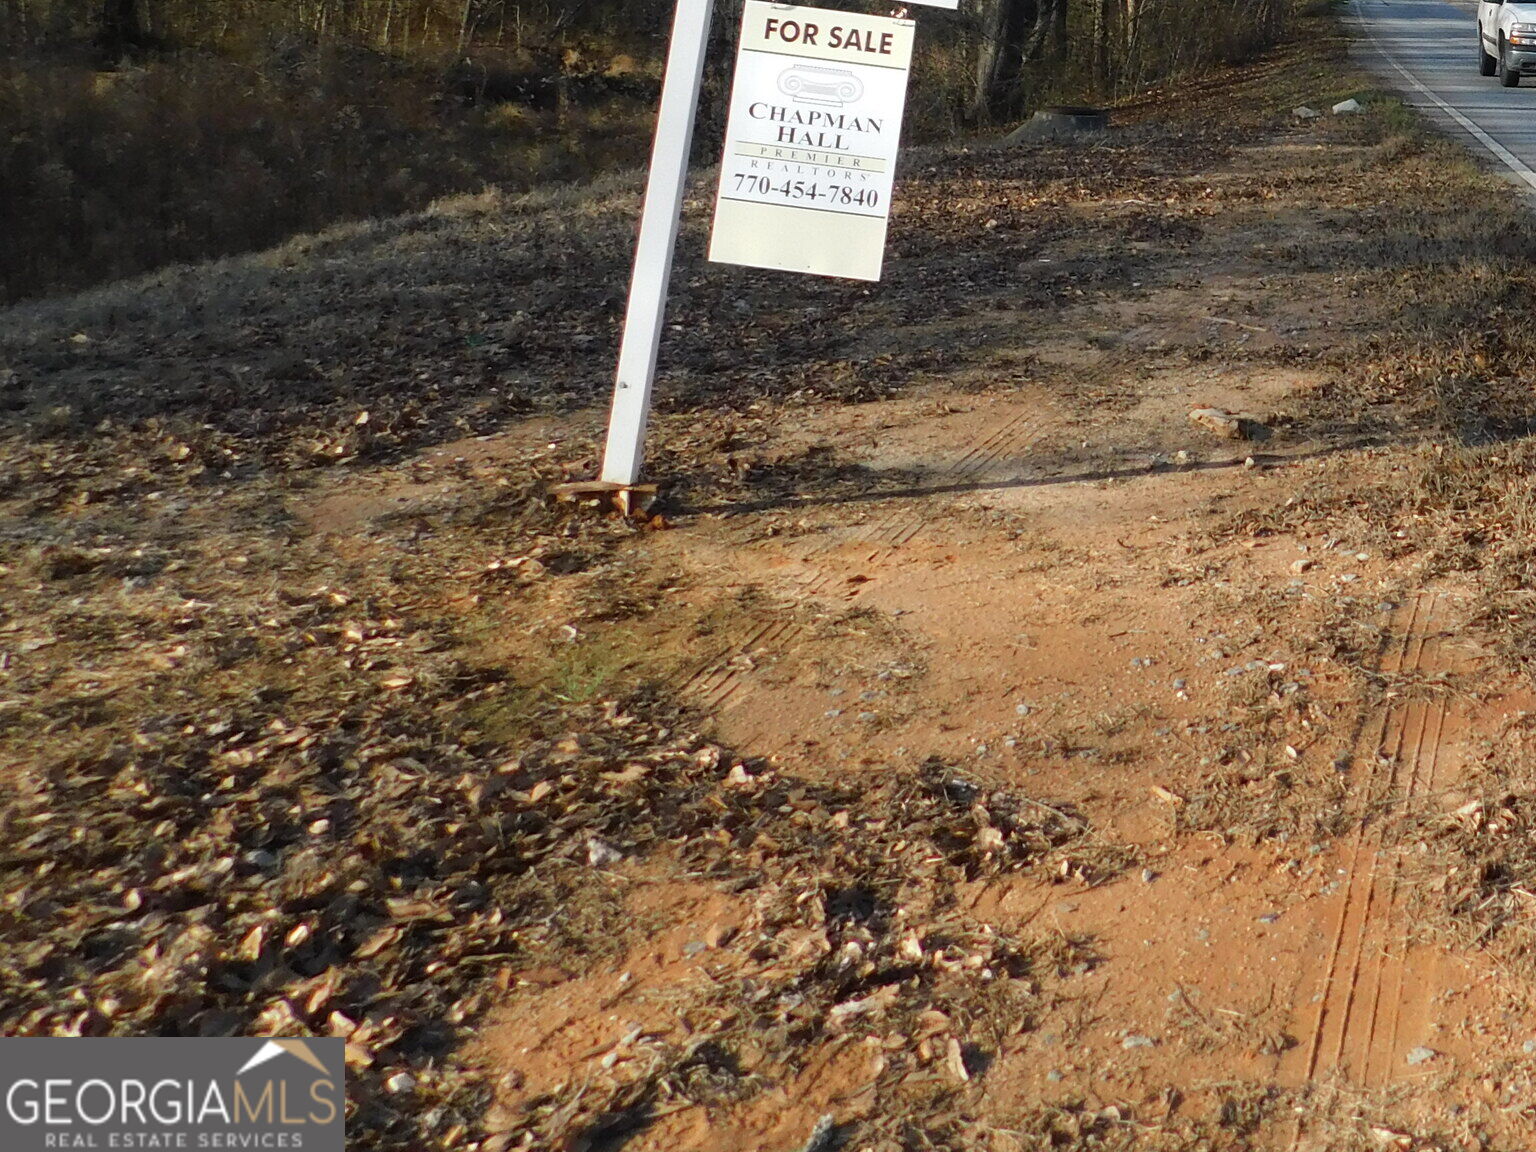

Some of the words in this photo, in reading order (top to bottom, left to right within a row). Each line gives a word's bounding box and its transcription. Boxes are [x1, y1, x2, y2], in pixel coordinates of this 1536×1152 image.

[764, 18, 819, 46] FOR
[827, 26, 894, 55] SALE
[748, 102, 883, 134] CHAPMAN
[777, 125, 849, 150] HALL
[760, 147, 861, 167] PREMIER
[734, 173, 878, 208] 770-454-7840
